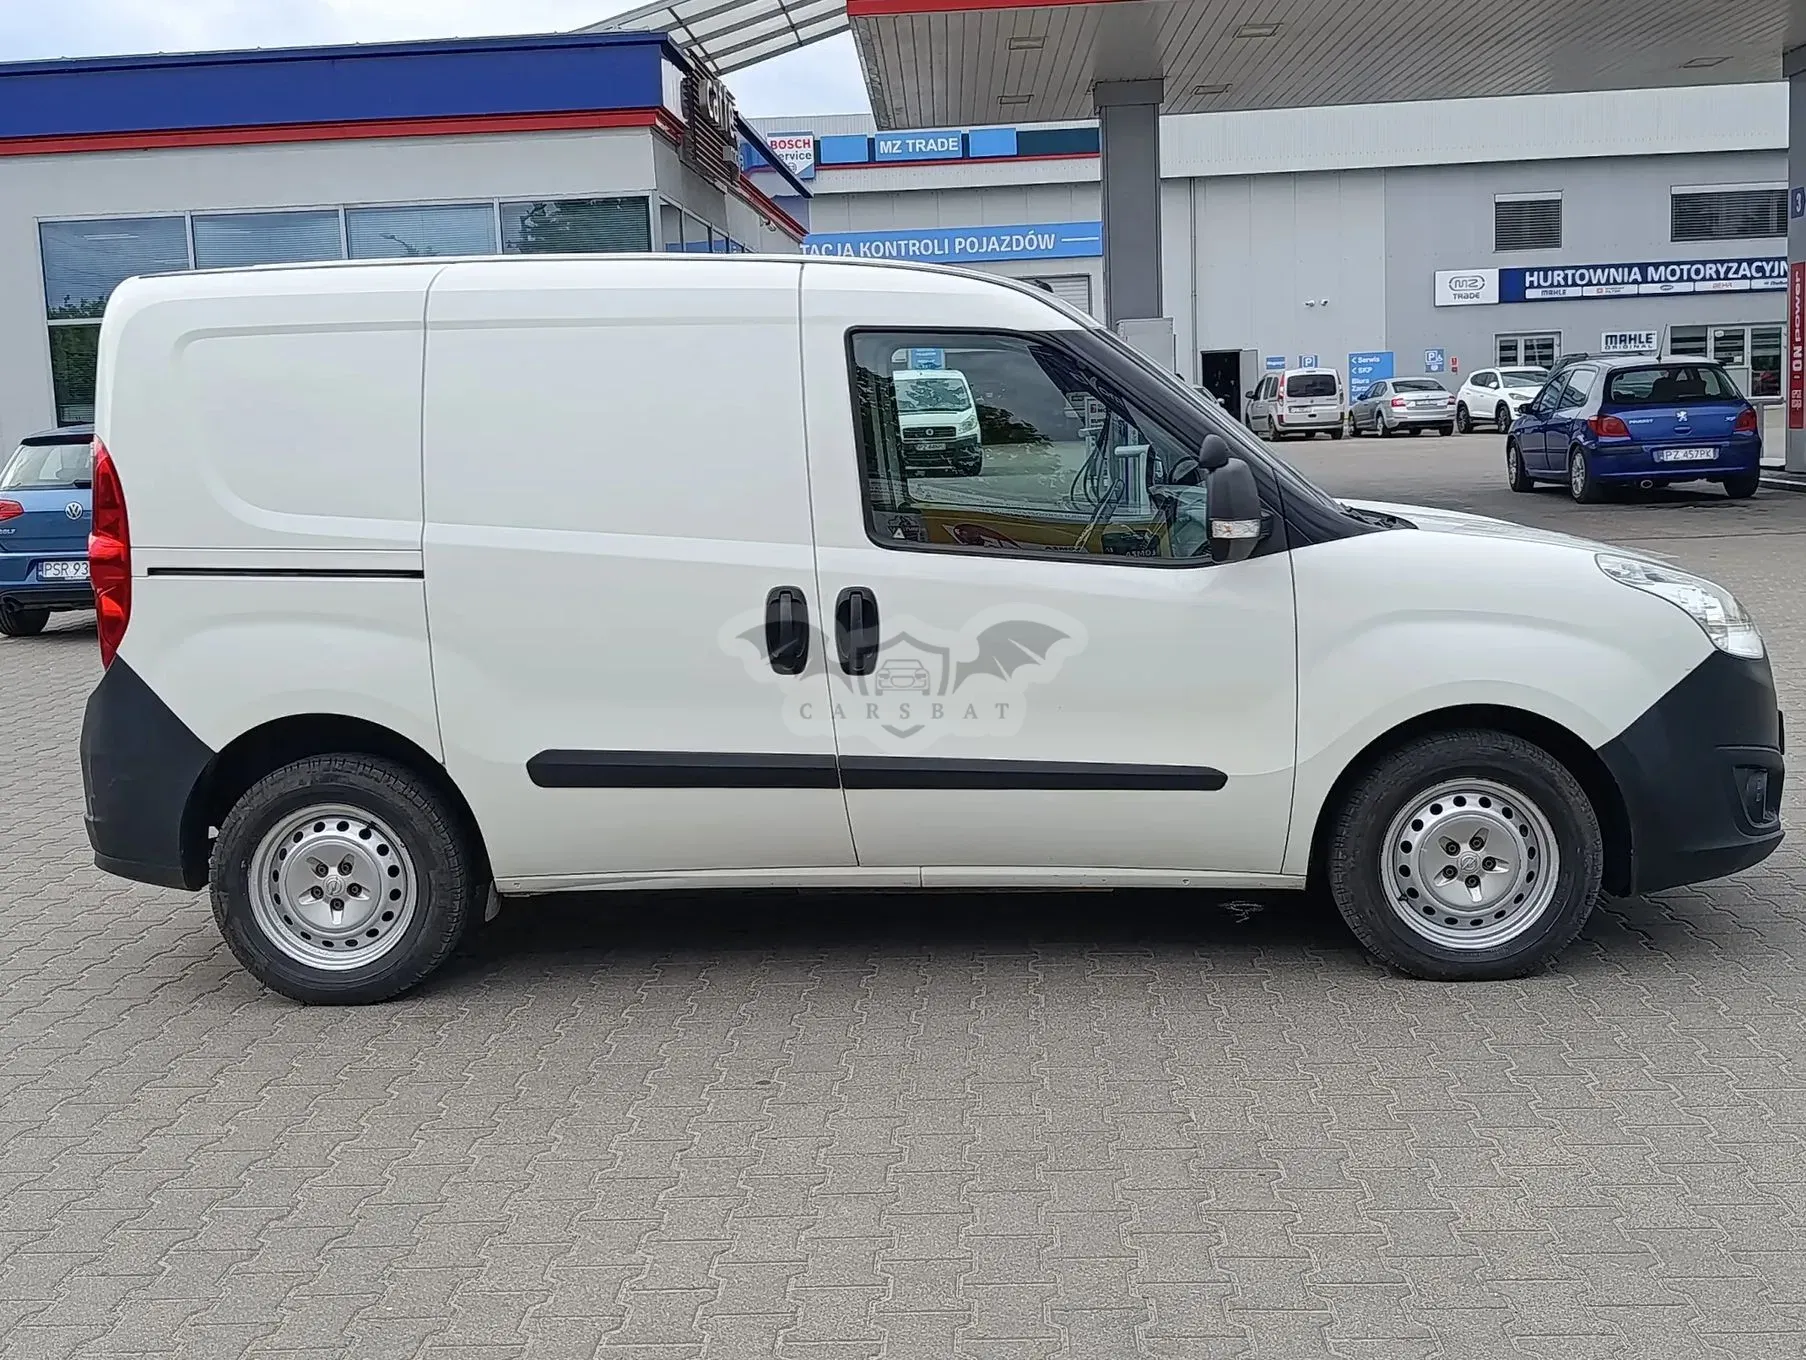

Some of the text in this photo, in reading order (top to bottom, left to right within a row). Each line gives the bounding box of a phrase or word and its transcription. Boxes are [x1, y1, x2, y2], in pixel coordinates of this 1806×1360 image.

[769, 138, 812, 150] BOSCH
[880, 137, 959, 154] MZ TRADE
[777, 150, 812, 160] ervice
[1795, 192, 1802, 213] 3
[800, 229, 1056, 258] TACJA KONTROLI POJAZDÓW
[1525, 260, 1788, 287] HURTOWNIA MOTORYZACYJN
[1605, 333, 1653, 346] MAHLE
[1665, 450, 1681, 460] PZ
[44, 561, 89, 576] PSR 93
